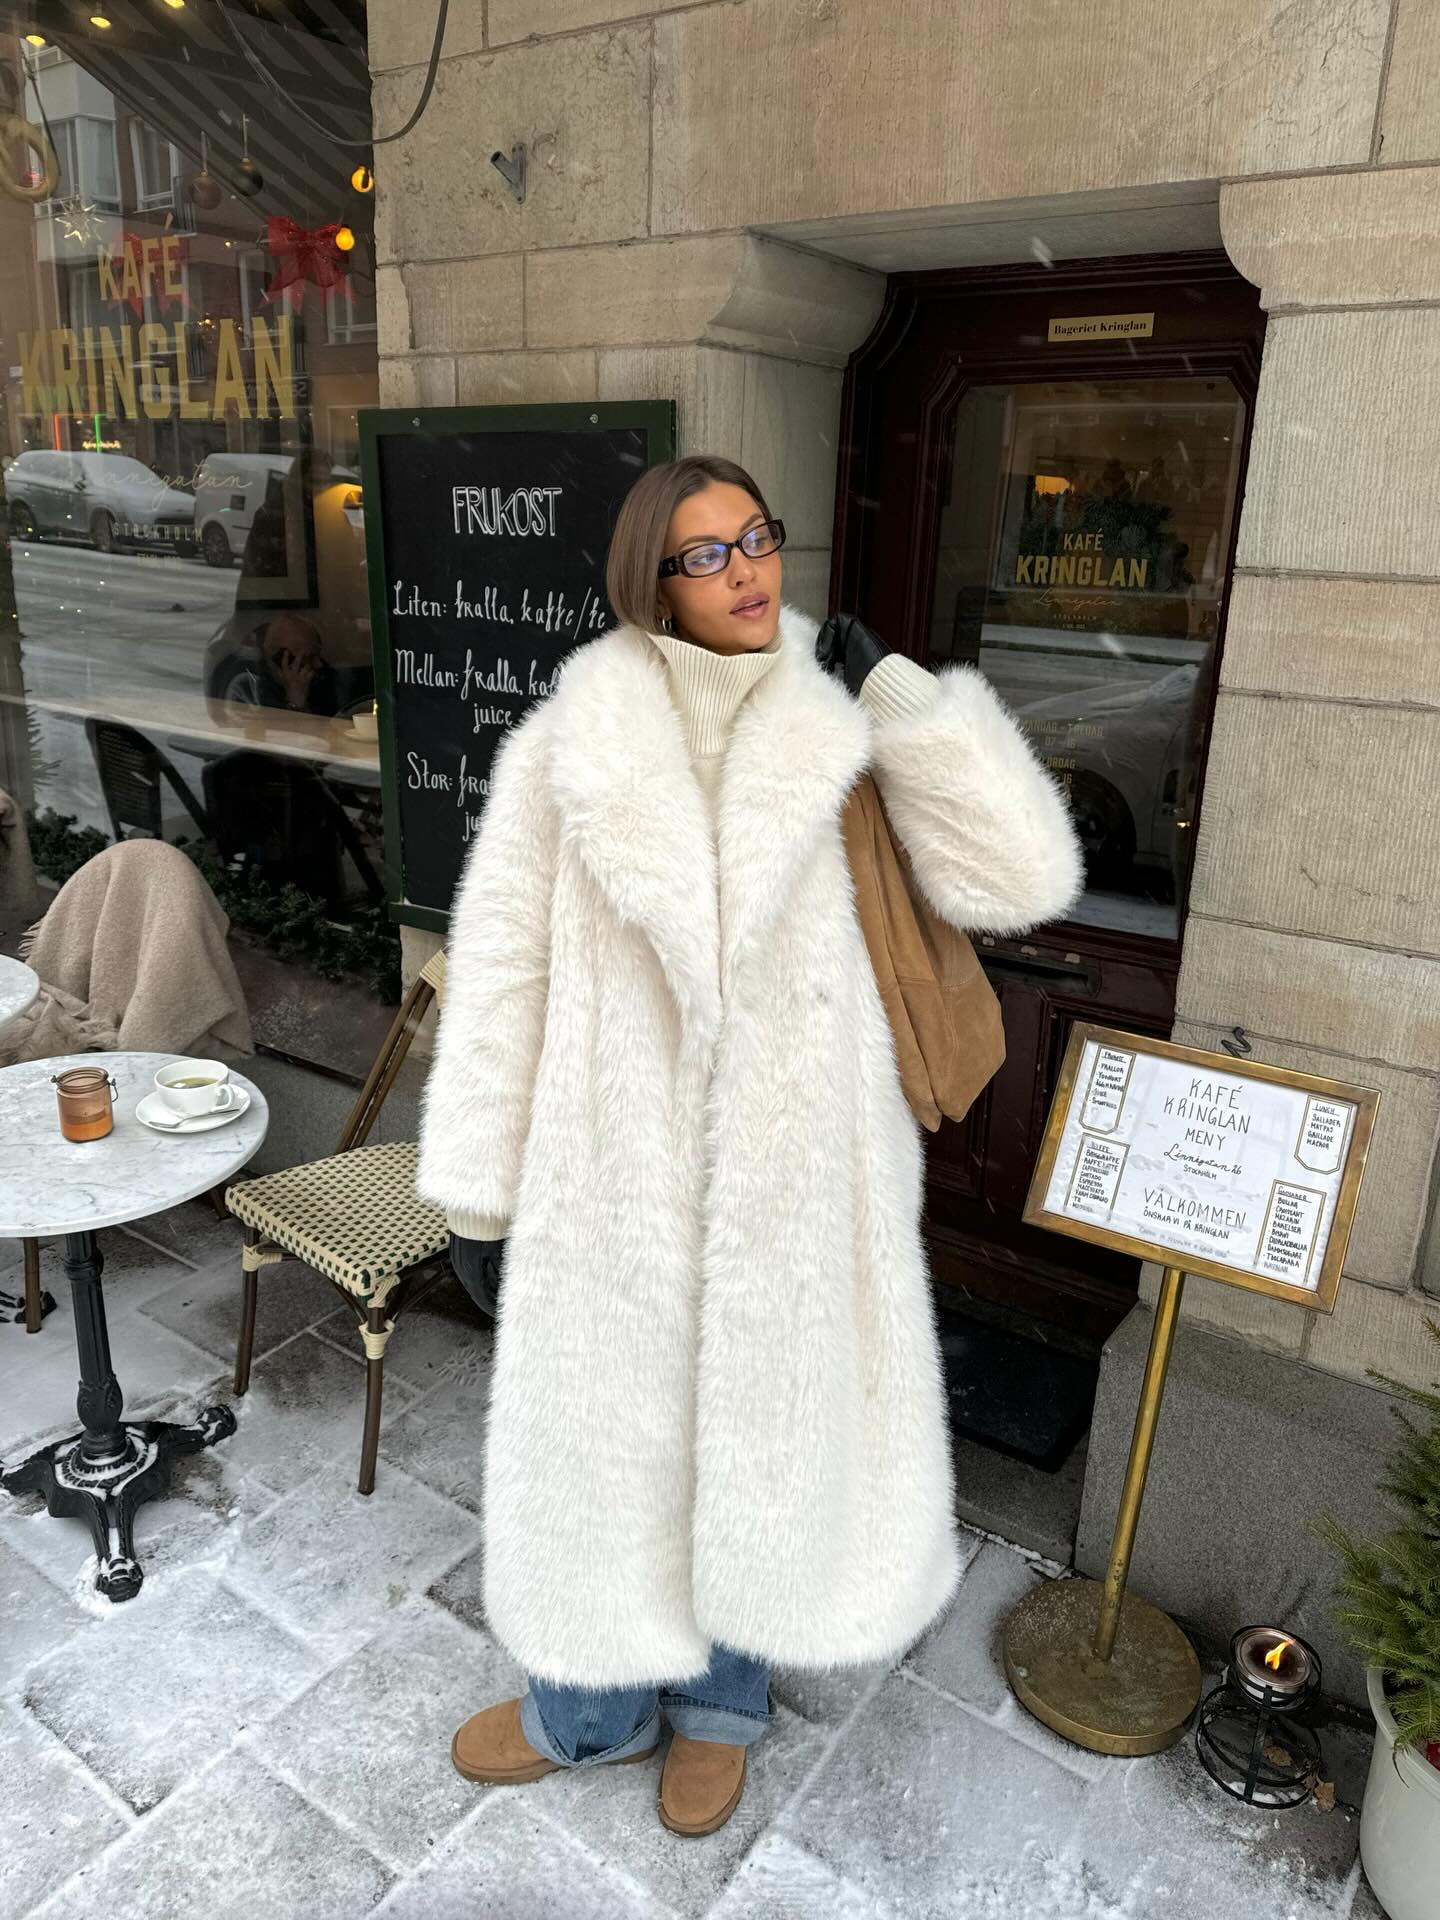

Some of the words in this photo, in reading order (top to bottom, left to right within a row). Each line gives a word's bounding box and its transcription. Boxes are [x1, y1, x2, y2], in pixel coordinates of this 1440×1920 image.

[98, 212, 183, 300] KAFÉ
[1054, 325, 1097, 335] Bageriet
[1100, 321, 1147, 333] Kringlan
[17, 315, 295, 418] KRINGLAN
[452, 486, 563, 537] FRUKOST
[112, 522, 203, 543] STOCKHOLM
[1063, 528, 1105, 551] KAFÉ
[1015, 555, 1148, 588] KRINGLAN
[393, 580, 447, 617] Liten:
[394, 648, 459, 687] Mellan:
[473, 703, 514, 734] juice
[407, 751, 453, 792] Stor:
[1189, 1078, 1243, 1109] KAFÉ
[1315, 1102, 1336, 1115] LUNCH
[1164, 1096, 1251, 1134] KRINGLAN
[1184, 1128, 1226, 1151] MENY
[1143, 1206, 1171, 1224] ÖNSKAR
[1173, 1217, 1179, 1225] VI
[1183, 1219, 1191, 1230] PÅ
[1194, 1222, 1230, 1239] KRINGLAN
[1144, 1187, 1247, 1229] VÄLKOMMEN
